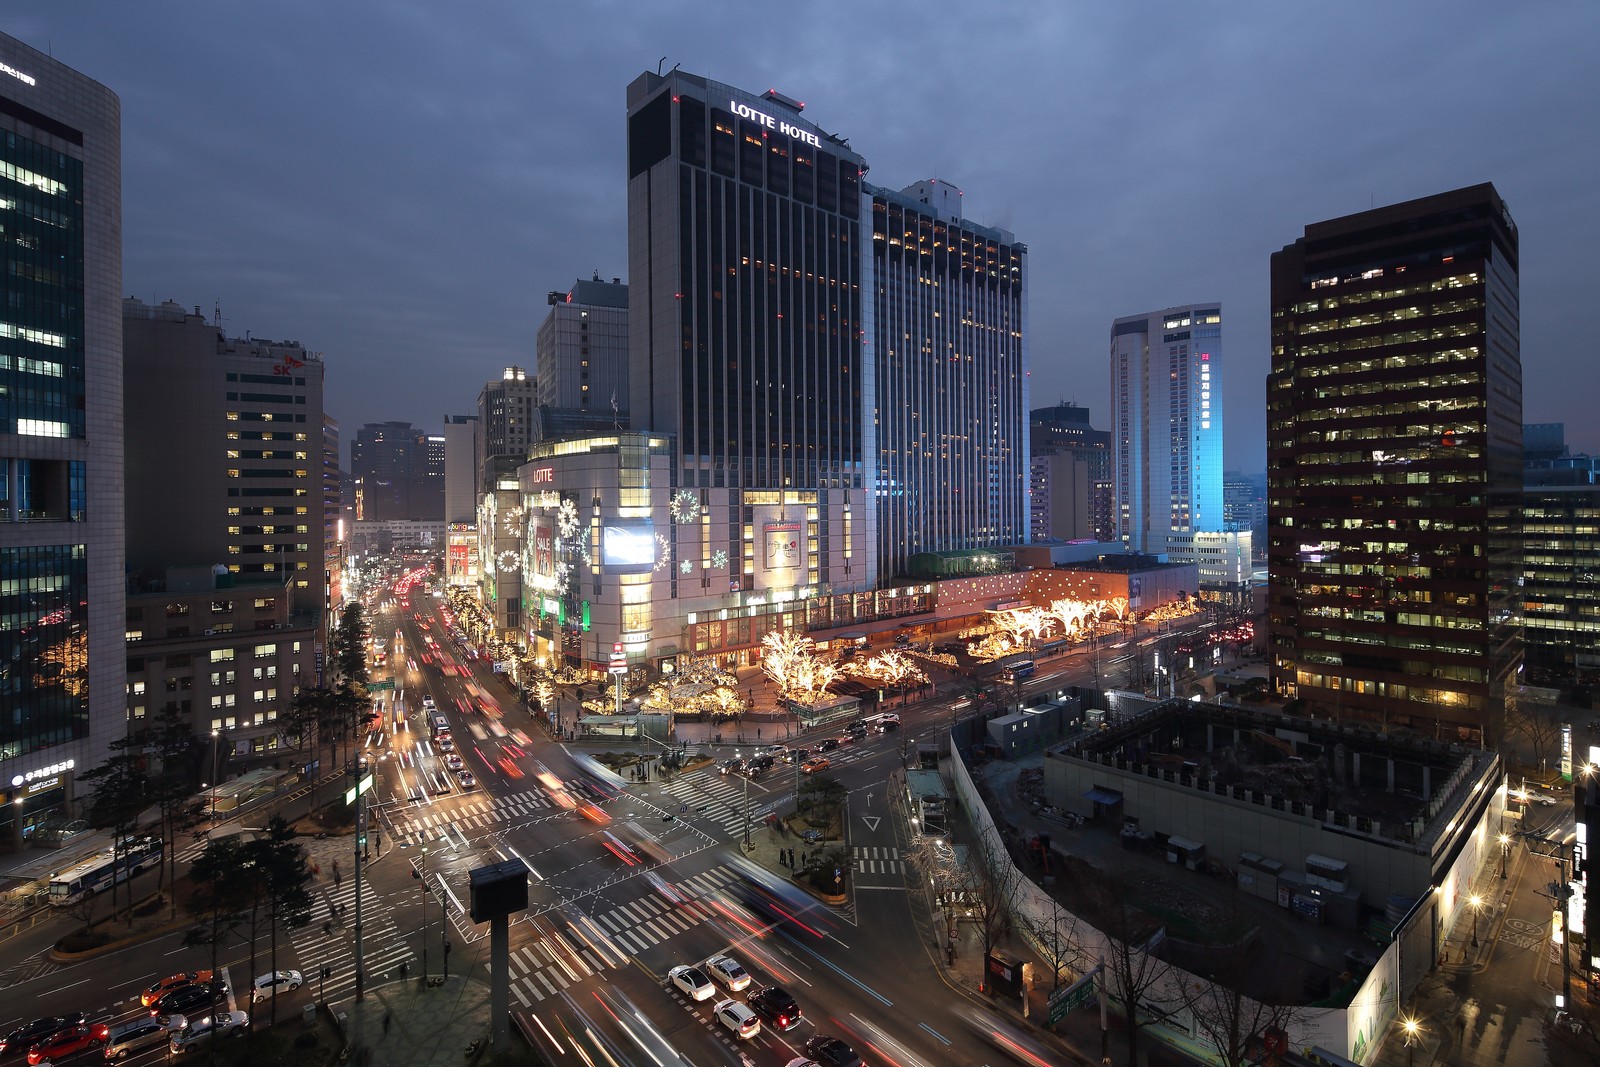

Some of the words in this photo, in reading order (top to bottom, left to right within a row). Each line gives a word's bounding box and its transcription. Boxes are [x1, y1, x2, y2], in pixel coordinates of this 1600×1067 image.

[730, 100, 775, 129] LOTTE
[780, 121, 822, 149] HOTEL
[273, 365, 292, 376] SK
[533, 468, 553, 483] LOTTE
[537, 537, 551, 551] SALE
[25, 759, 74, 781] 우리종합금융
